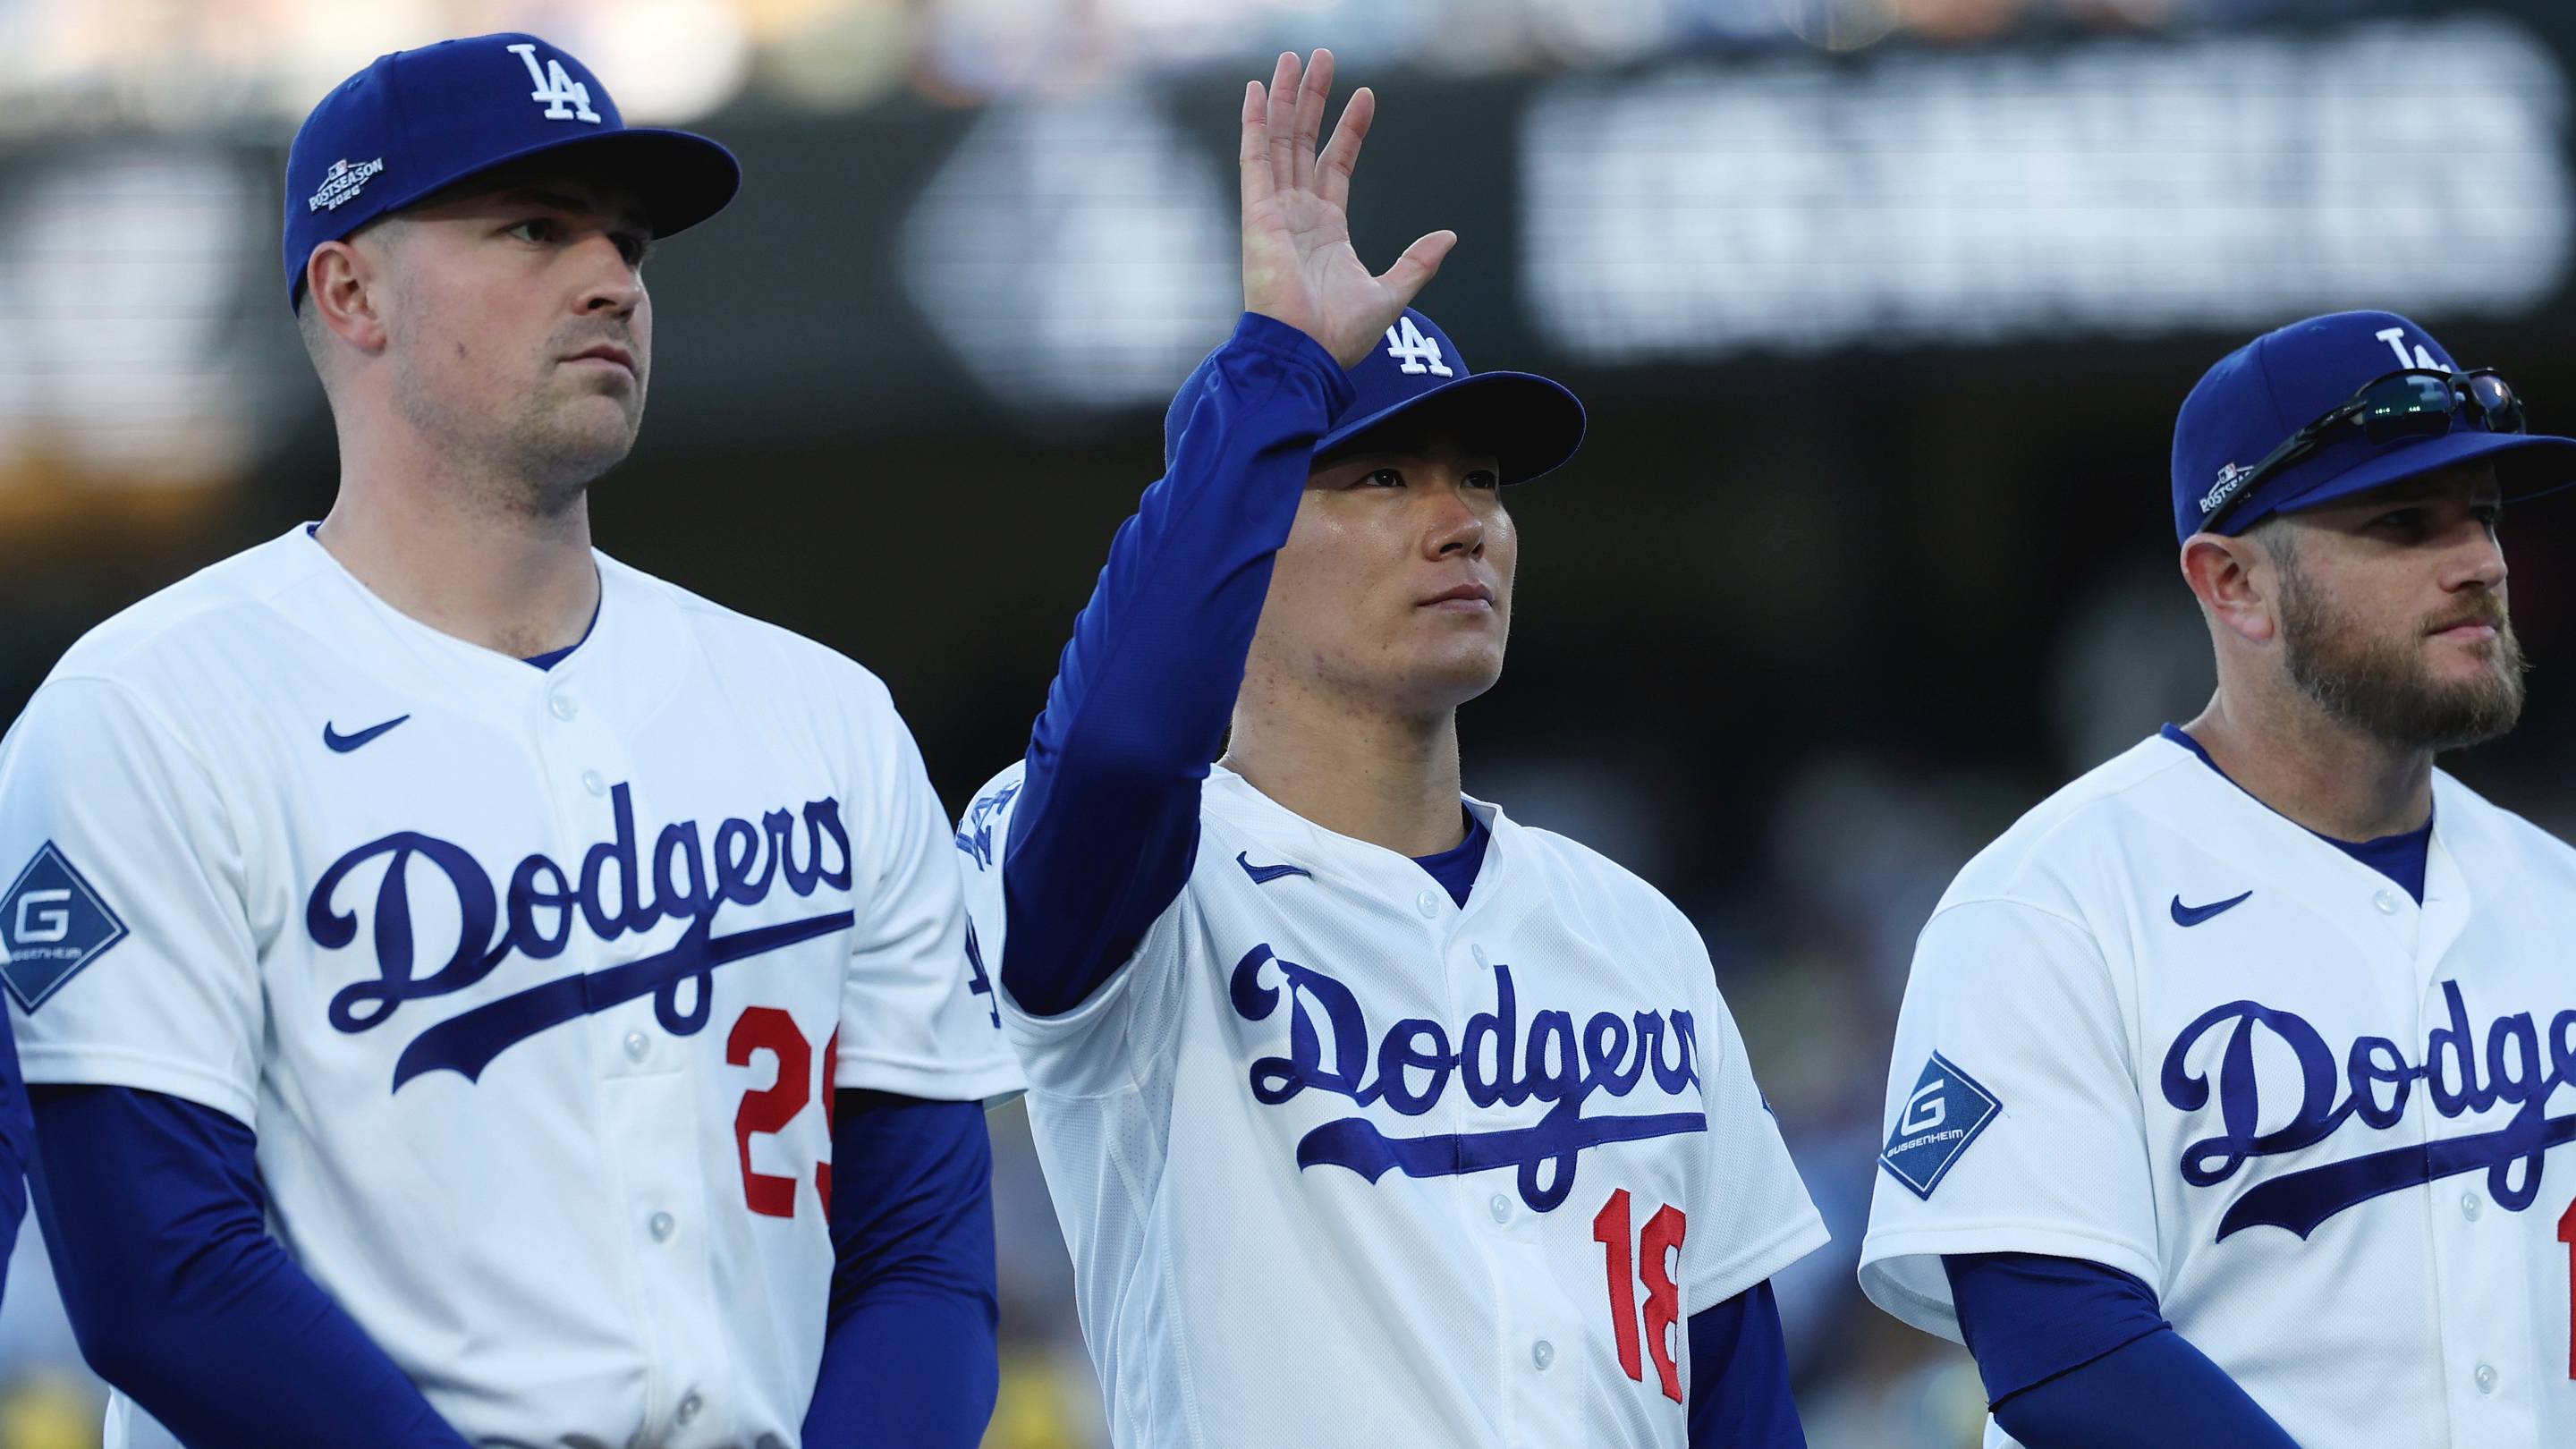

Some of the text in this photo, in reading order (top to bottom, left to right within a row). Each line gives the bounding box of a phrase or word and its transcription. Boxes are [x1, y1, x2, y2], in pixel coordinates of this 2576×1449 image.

[506, 44, 601, 123] LA
[309, 157, 384, 212] POSTSEASON
[1385, 317, 1453, 377] LA
[14, 888, 72, 944] G
[307, 782, 853, 1036] Dodgers
[1230, 943, 1704, 1212] Dodgers
[1901, 1079, 1946, 1137] G
[1886, 1129, 1964, 1158] GUGGENHEIM
[1593, 1188, 1687, 1405] 18
